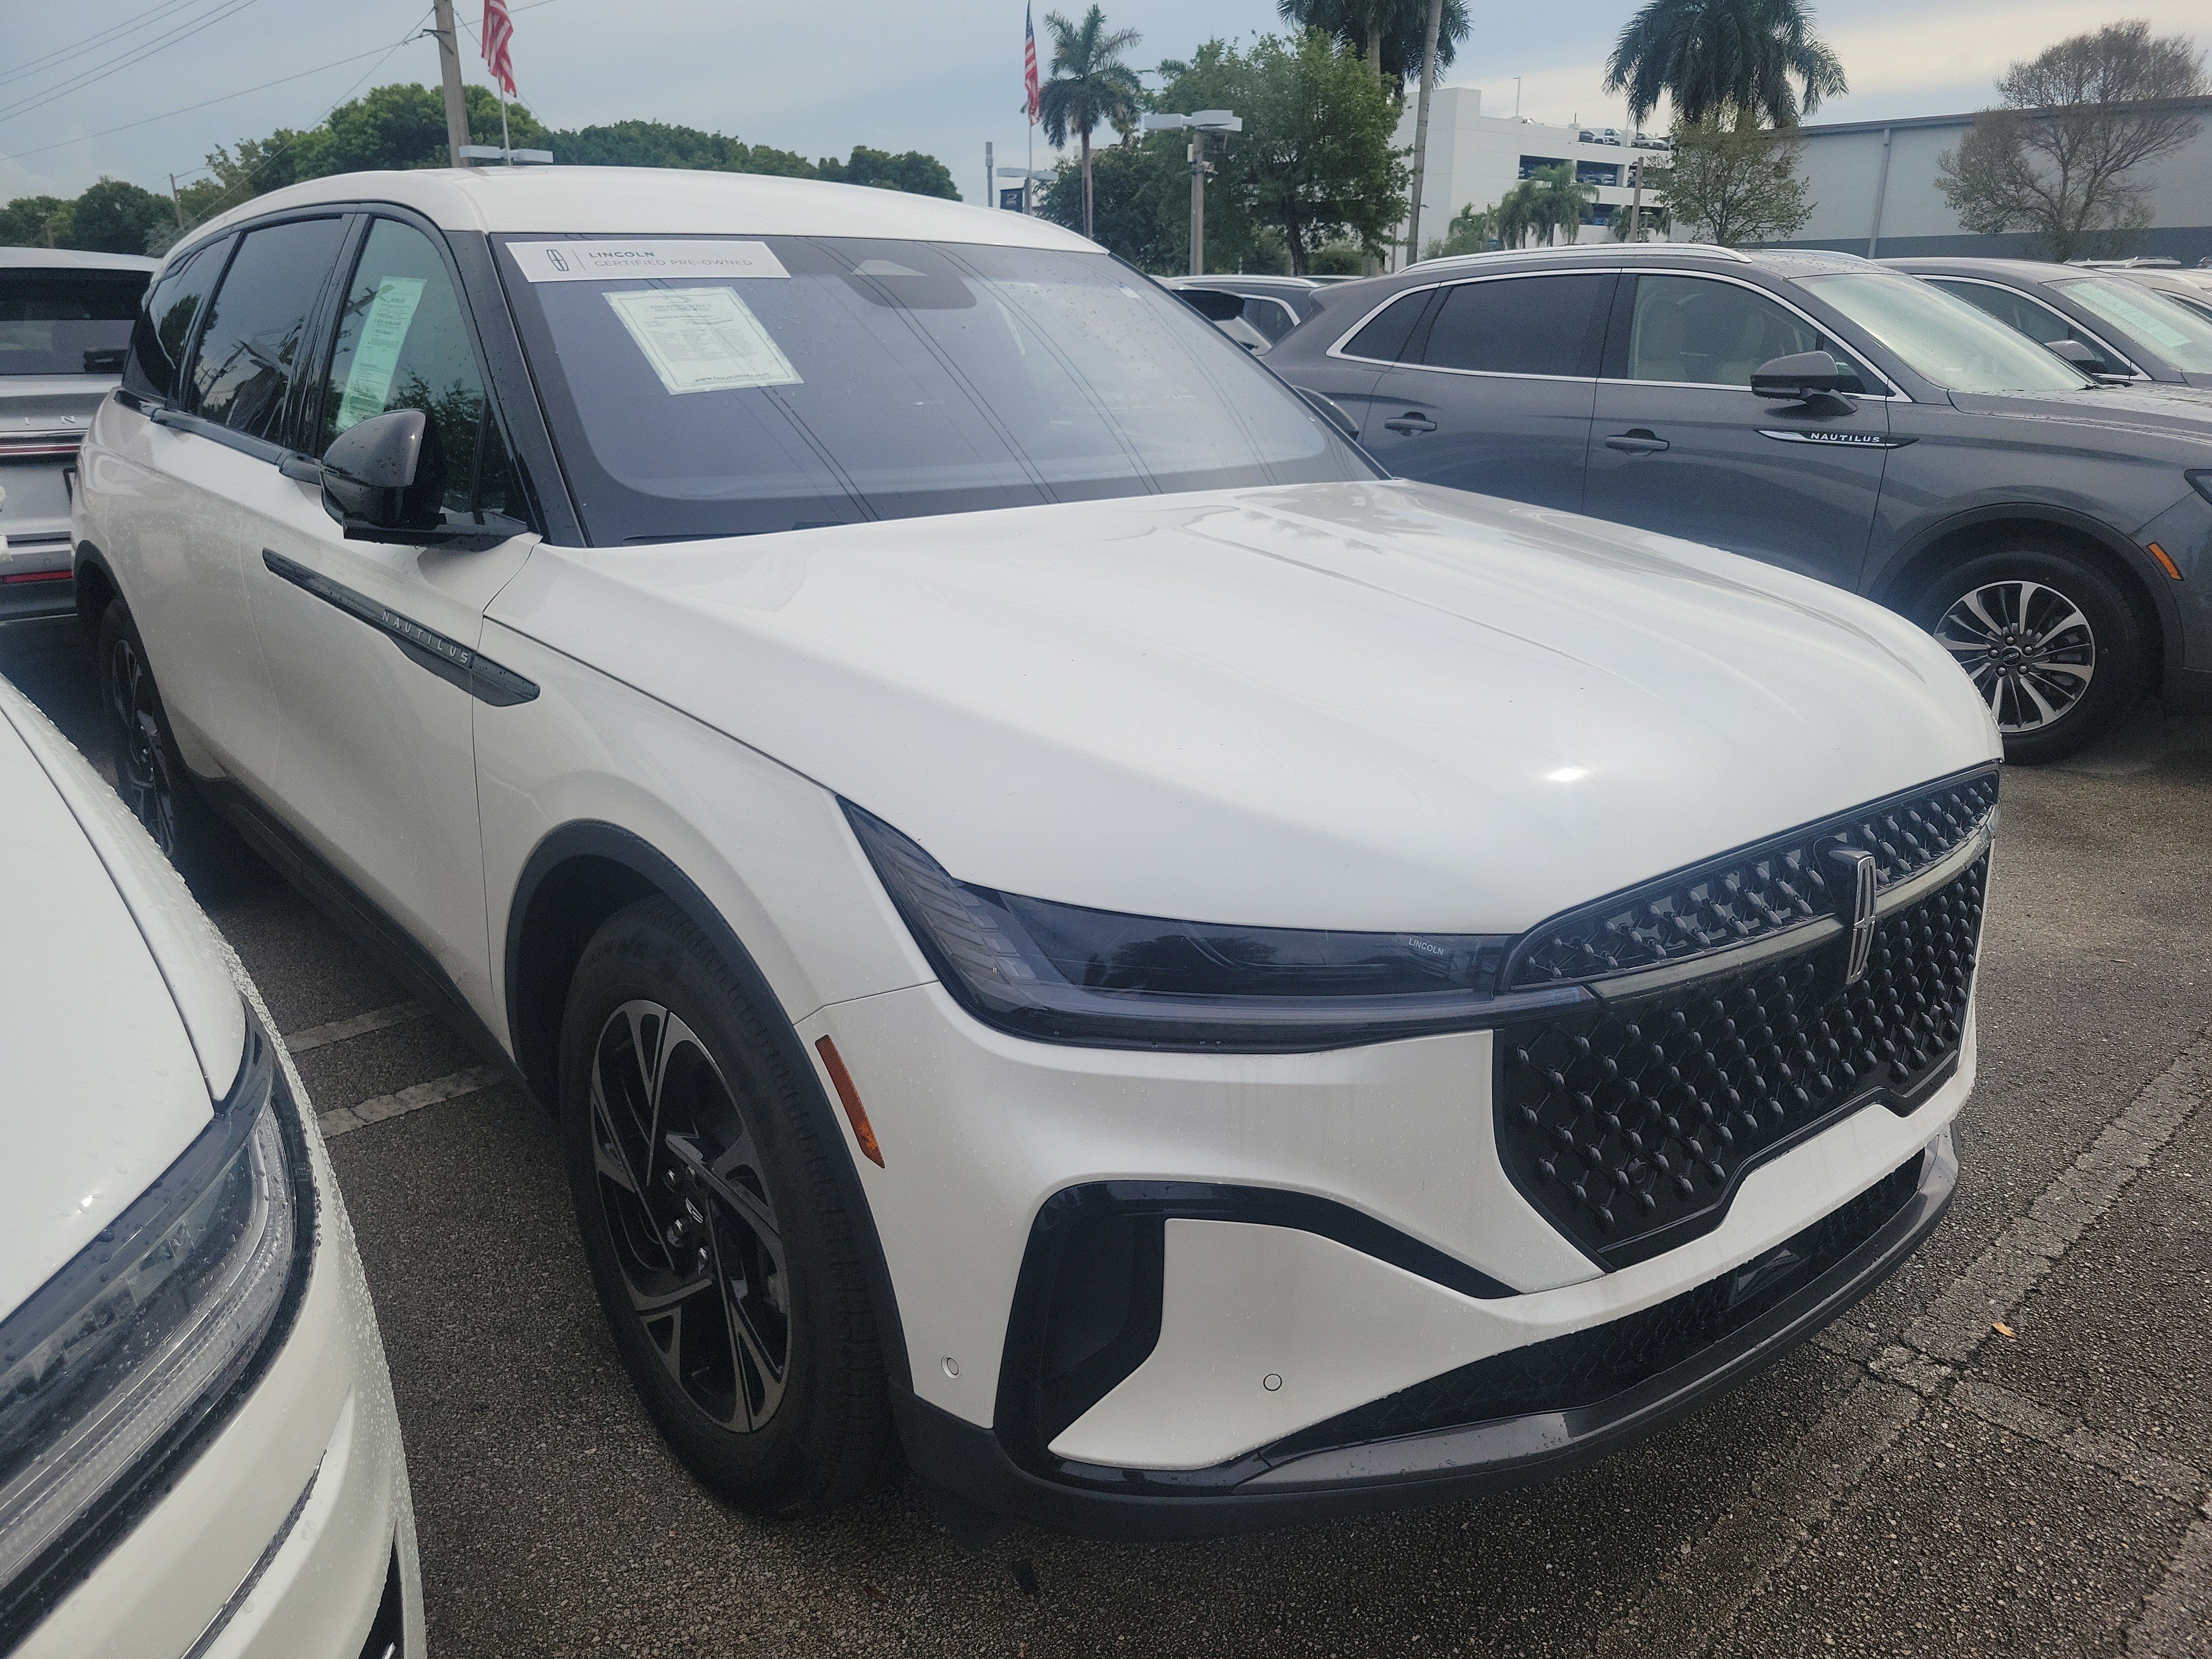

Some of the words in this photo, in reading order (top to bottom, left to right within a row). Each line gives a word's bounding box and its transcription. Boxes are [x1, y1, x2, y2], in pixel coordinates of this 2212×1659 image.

[1810, 432, 1880, 443] NAUTILUS
[382, 610, 469, 664] NAUTILUS
[1408, 938, 1444, 956] LINCOLN
